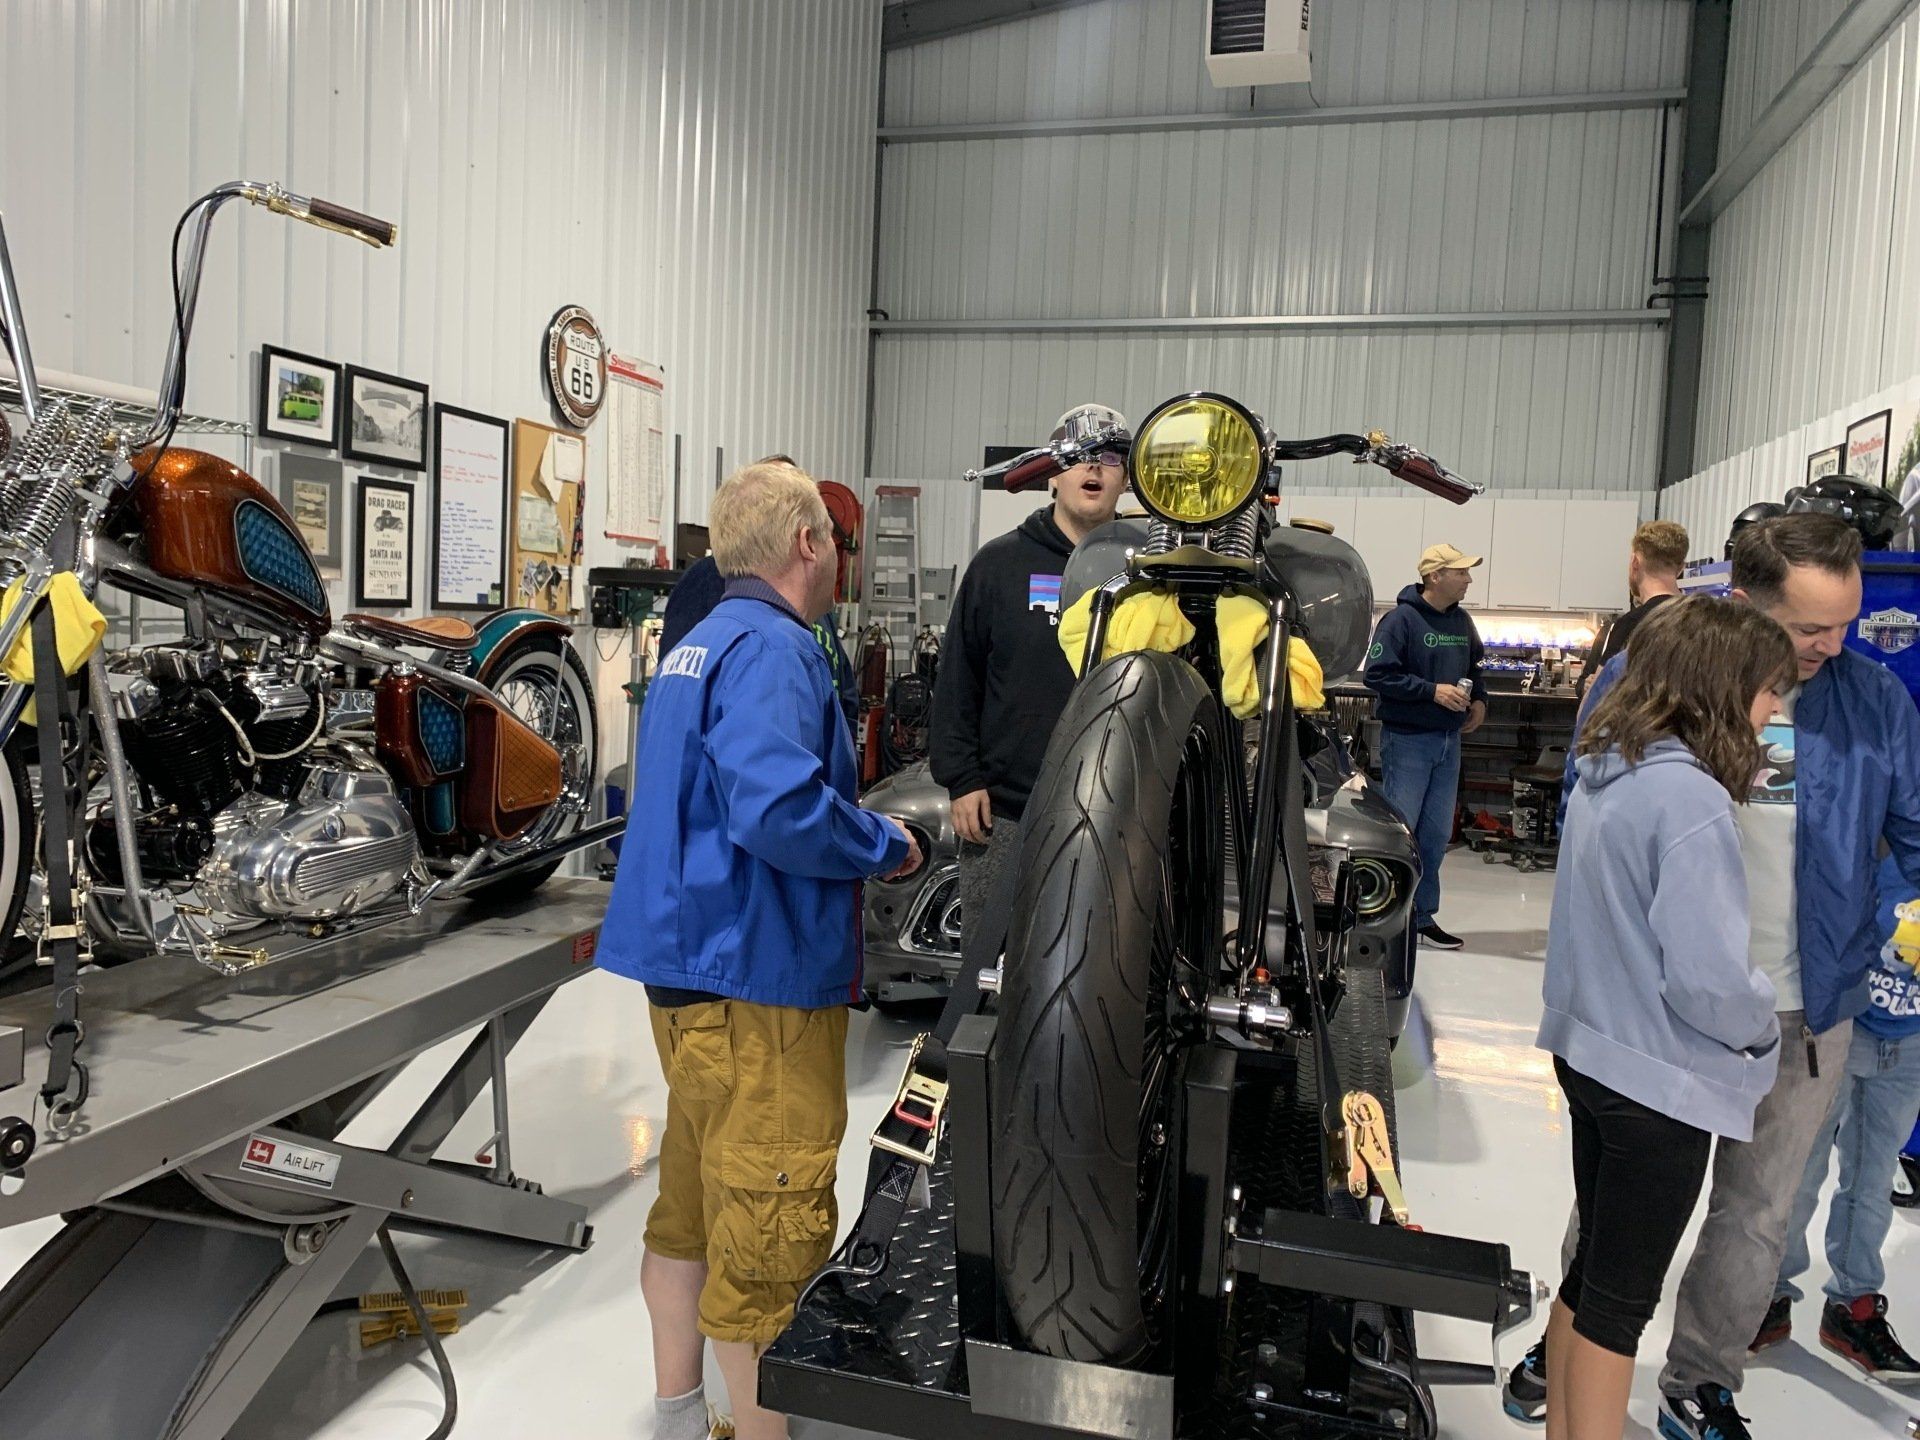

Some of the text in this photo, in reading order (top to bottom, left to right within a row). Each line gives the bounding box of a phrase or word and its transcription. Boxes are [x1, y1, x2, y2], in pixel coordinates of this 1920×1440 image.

[570, 335, 595, 354] ROUTE
[551, 368, 567, 411] CALIFORNIA
[572, 367, 593, 400] 66
[368, 496, 406, 511] DRAG RACES
[370, 548, 402, 560] SANTA ANA
[369, 569, 402, 579] SUNDAYS
[1879, 613, 1908, 624] MOTOR
[1869, 970, 1906, 994] HO'S
[284, 1152, 325, 1173] AIR LIFT
